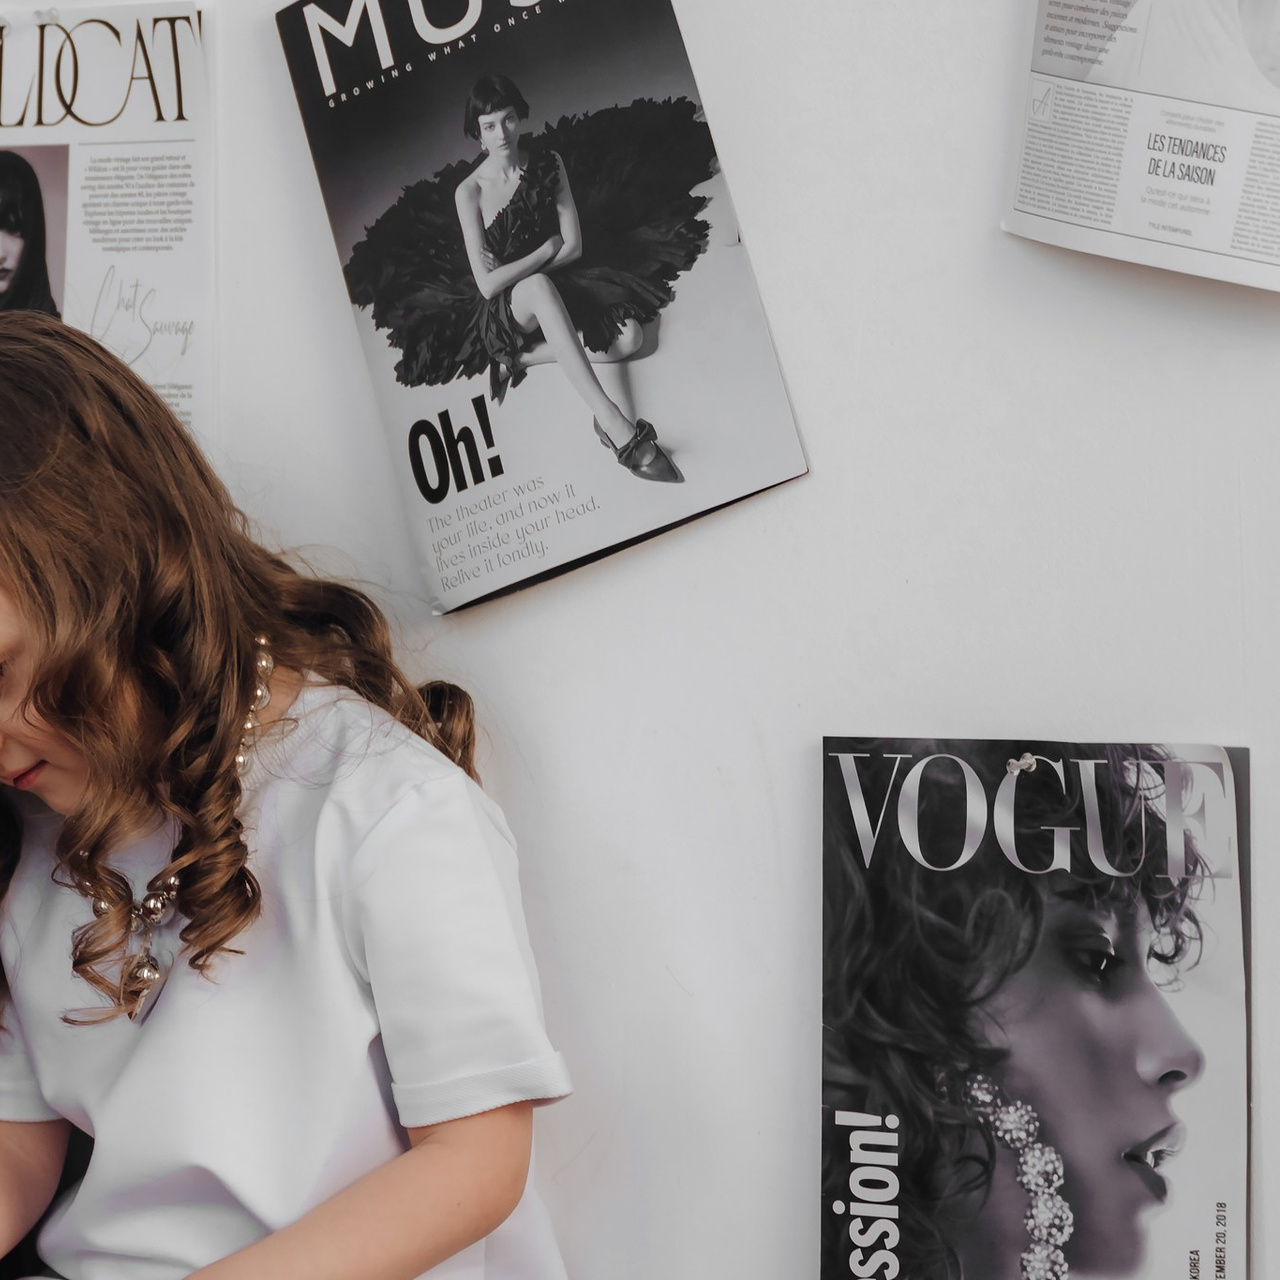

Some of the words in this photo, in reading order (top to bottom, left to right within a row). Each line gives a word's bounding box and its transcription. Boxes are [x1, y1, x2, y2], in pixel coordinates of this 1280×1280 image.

[328, 62, 413, 108] GROWING
[427, 33, 477, 62] WHAT
[493, 5, 542, 33] ONCE
[1147, 132, 1166, 152] LES
[1167, 135, 1228, 163] TENDANCES
[1148, 157, 1163, 176] DE
[1163, 160, 1176, 179] LA
[1177, 162, 1216, 187] SAISON
[407, 393, 505, 505] Oh!
[426, 513, 452, 533] The
[455, 489, 508, 521] theater
[512, 476, 545, 498] was
[431, 531, 462, 556] your
[466, 520, 493, 538] life,
[495, 501, 525, 526] and
[528, 490, 561, 513] now
[564, 483, 576, 499] it
[435, 550, 466, 573] lives
[467, 532, 510, 558] inside
[515, 514, 551, 545] your
[554, 495, 601, 524] head.
[439, 564, 481, 593] Relive
[483, 558, 494, 573] it
[496, 540, 549, 568] fondly.
[828, 751, 1234, 879] VOGUE
[1215, 1201, 1227, 1227] 2018
[1215, 1229, 1227, 1244] 20,
[1189, 1249, 1200, 1280] KOREA
